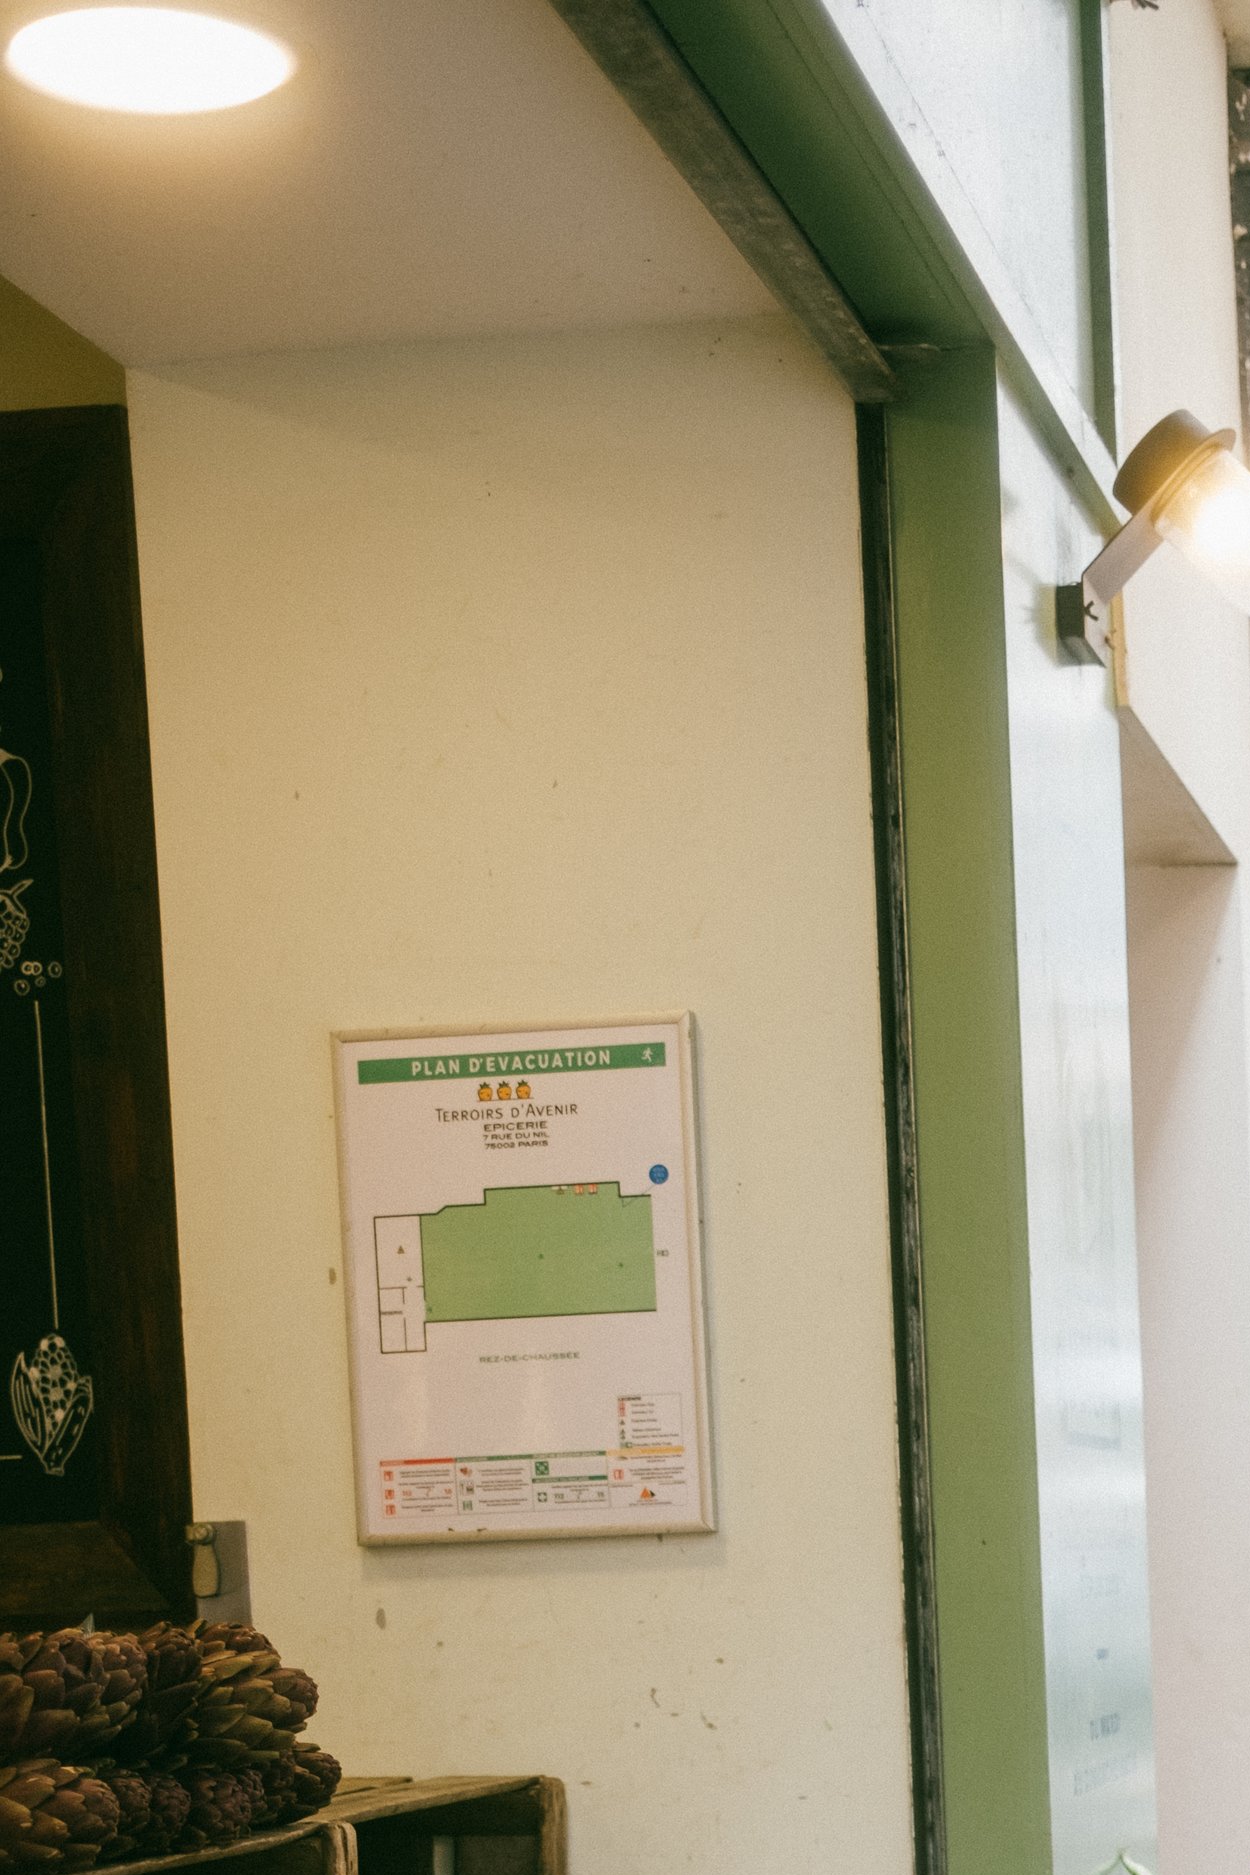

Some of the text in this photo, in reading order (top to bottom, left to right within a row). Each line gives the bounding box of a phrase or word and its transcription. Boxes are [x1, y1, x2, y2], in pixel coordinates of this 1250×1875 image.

[411, 1050, 611, 1077] PLAN D'EVACUATION
[435, 1107, 504, 1122] TERROIRS
[483, 1120, 548, 1132] EPICERIE
[491, 1133, 513, 1141] RUE
[533, 1131, 549, 1139] NIL
[485, 1140, 548, 1150] 75002 PARIS
